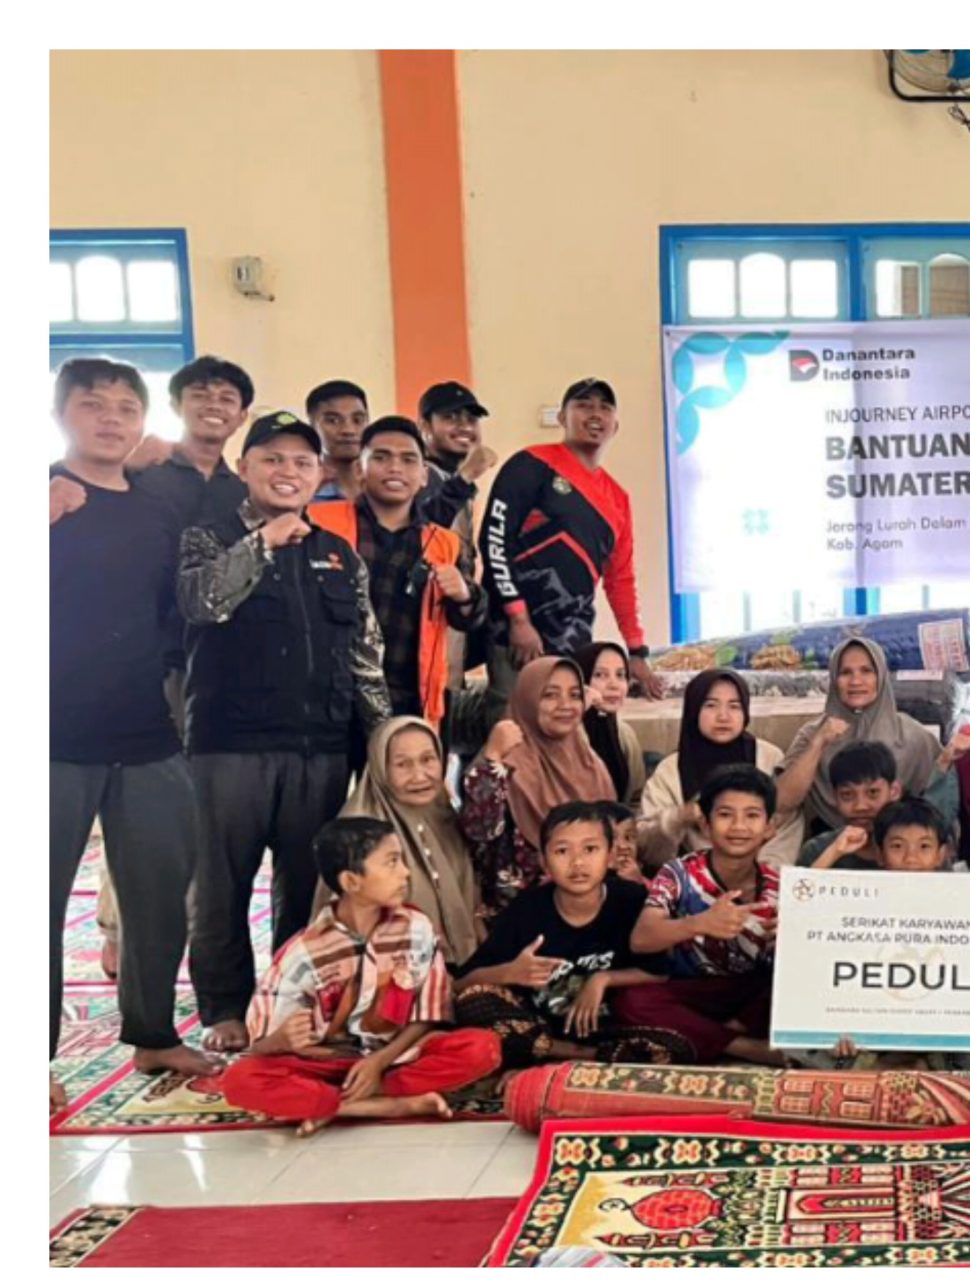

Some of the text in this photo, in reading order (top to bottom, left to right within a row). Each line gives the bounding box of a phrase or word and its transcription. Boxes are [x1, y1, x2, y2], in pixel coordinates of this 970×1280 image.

[822, 347, 915, 362] Danantara
[823, 366, 911, 381] Indonesia
[825, 407, 918, 424] INJOURNEY
[487, 498, 519, 596] GURILA
[863, 538, 904, 553] Agam
[817, 885, 880, 898] PEDULI
[841, 916, 896, 929] SERIKAT
[807, 930, 823, 941] PT
[827, 931, 892, 943] ANGKASA
[894, 932, 931, 944] PURA
